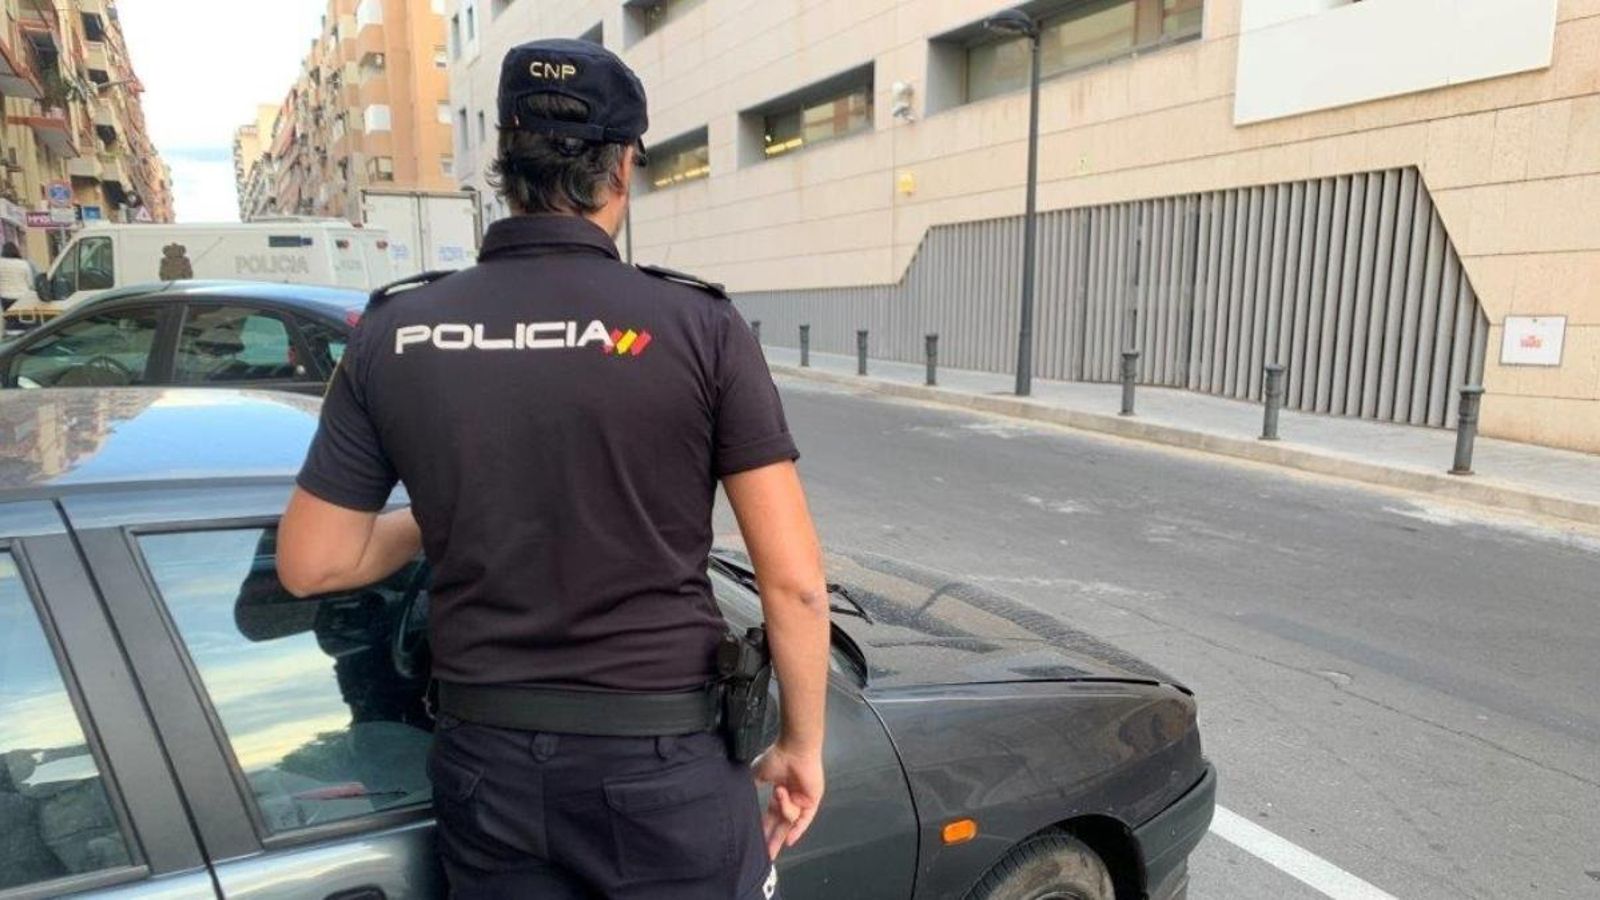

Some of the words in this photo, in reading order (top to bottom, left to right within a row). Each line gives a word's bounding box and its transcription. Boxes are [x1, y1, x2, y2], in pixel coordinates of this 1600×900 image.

[529, 62, 576, 79] CNP
[235, 255, 309, 273] POLICIA
[395, 320, 614, 354] POLICIA
